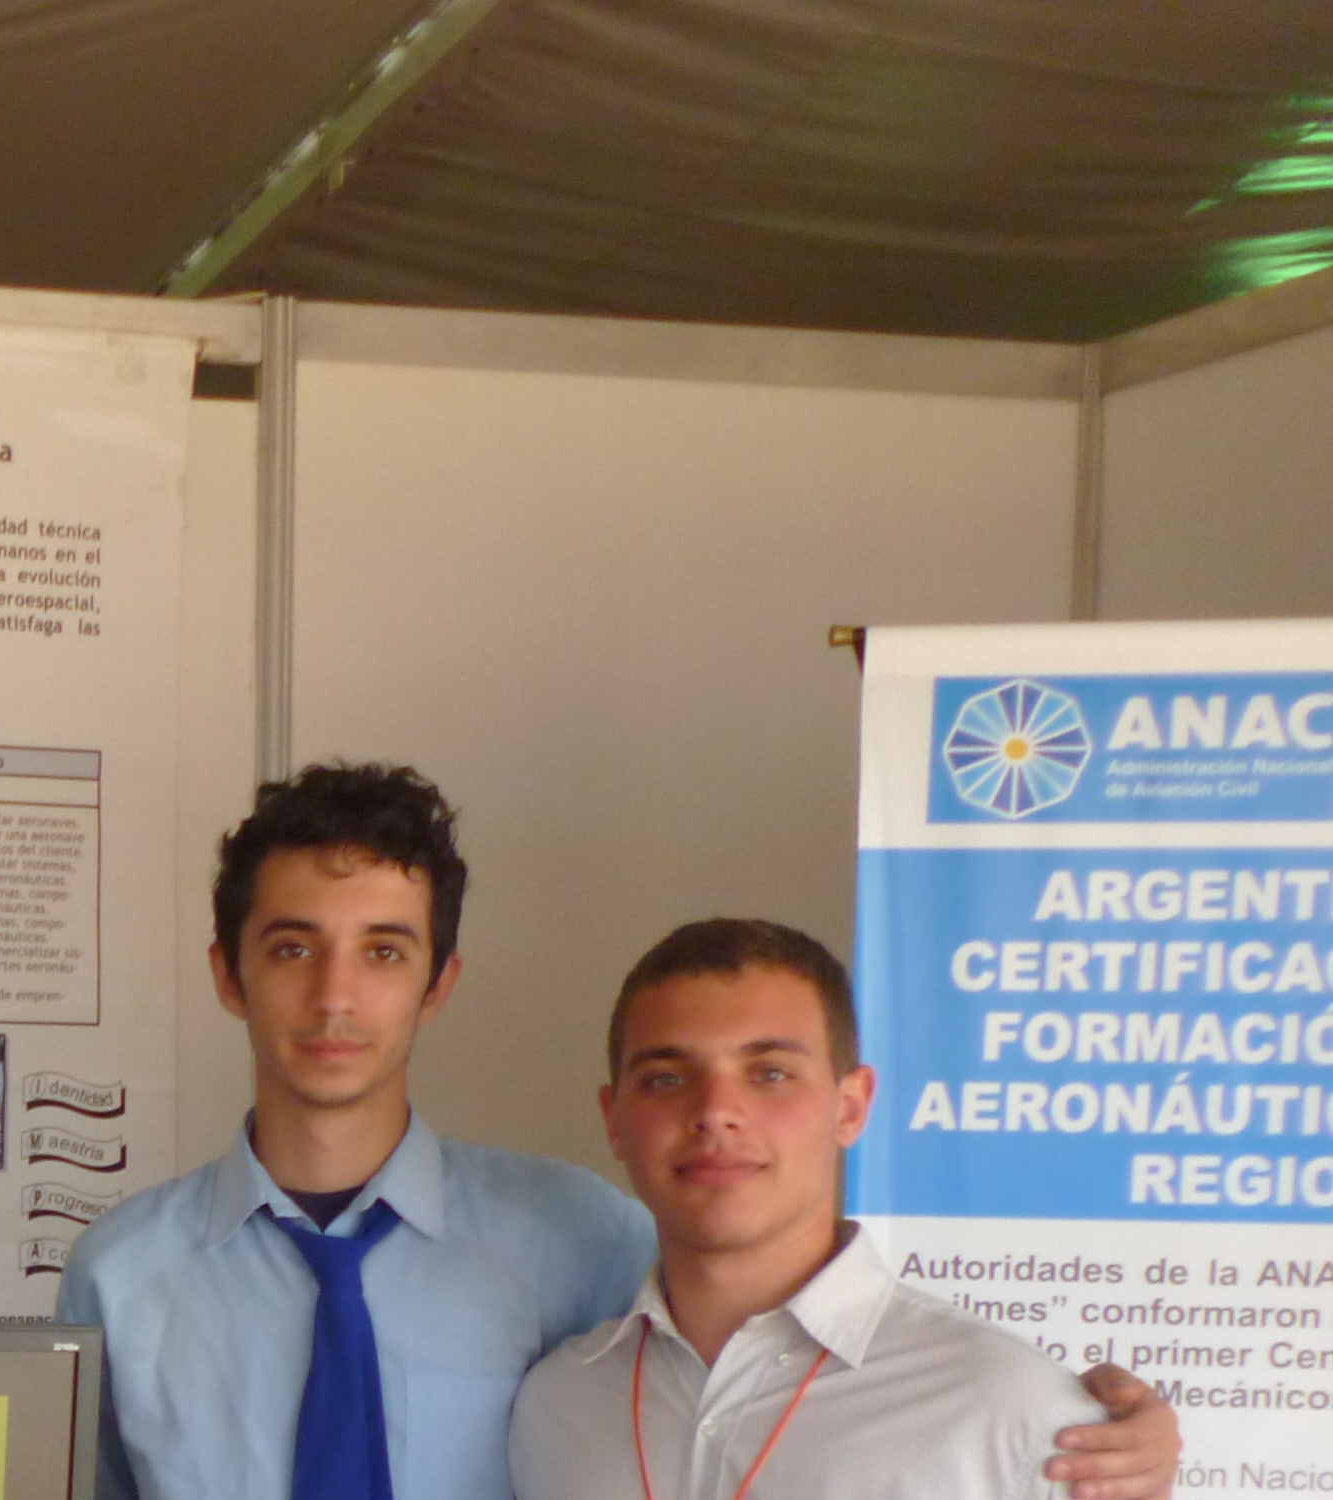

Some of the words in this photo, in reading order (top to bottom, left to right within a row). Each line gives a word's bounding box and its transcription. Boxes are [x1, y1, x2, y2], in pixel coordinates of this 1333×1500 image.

[38, 520, 102, 541] técnica
[54, 548, 77, 563] en
[84, 546, 101, 565] el
[17, 568, 101, 588] evolución
[1107, 692, 1332, 750] ANAC
[1218, 779, 1260, 796] Civil
[1033, 867, 1332, 922] ARGENT
[950, 940, 1332, 994] CERTIFICA
[908, 1070, 1332, 1137] AERONÁUTI
[899, 1252, 1125, 1285] Autoridades
[1144, 1258, 1189, 1286] de
[1208, 1259, 1238, 1287] la
[1080, 1298, 1321, 1329] conformaron
[1083, 1338, 1115, 1364] el
[1132, 1339, 1254, 1371] primer
[1154, 1380, 1332, 1410] Mecánico
